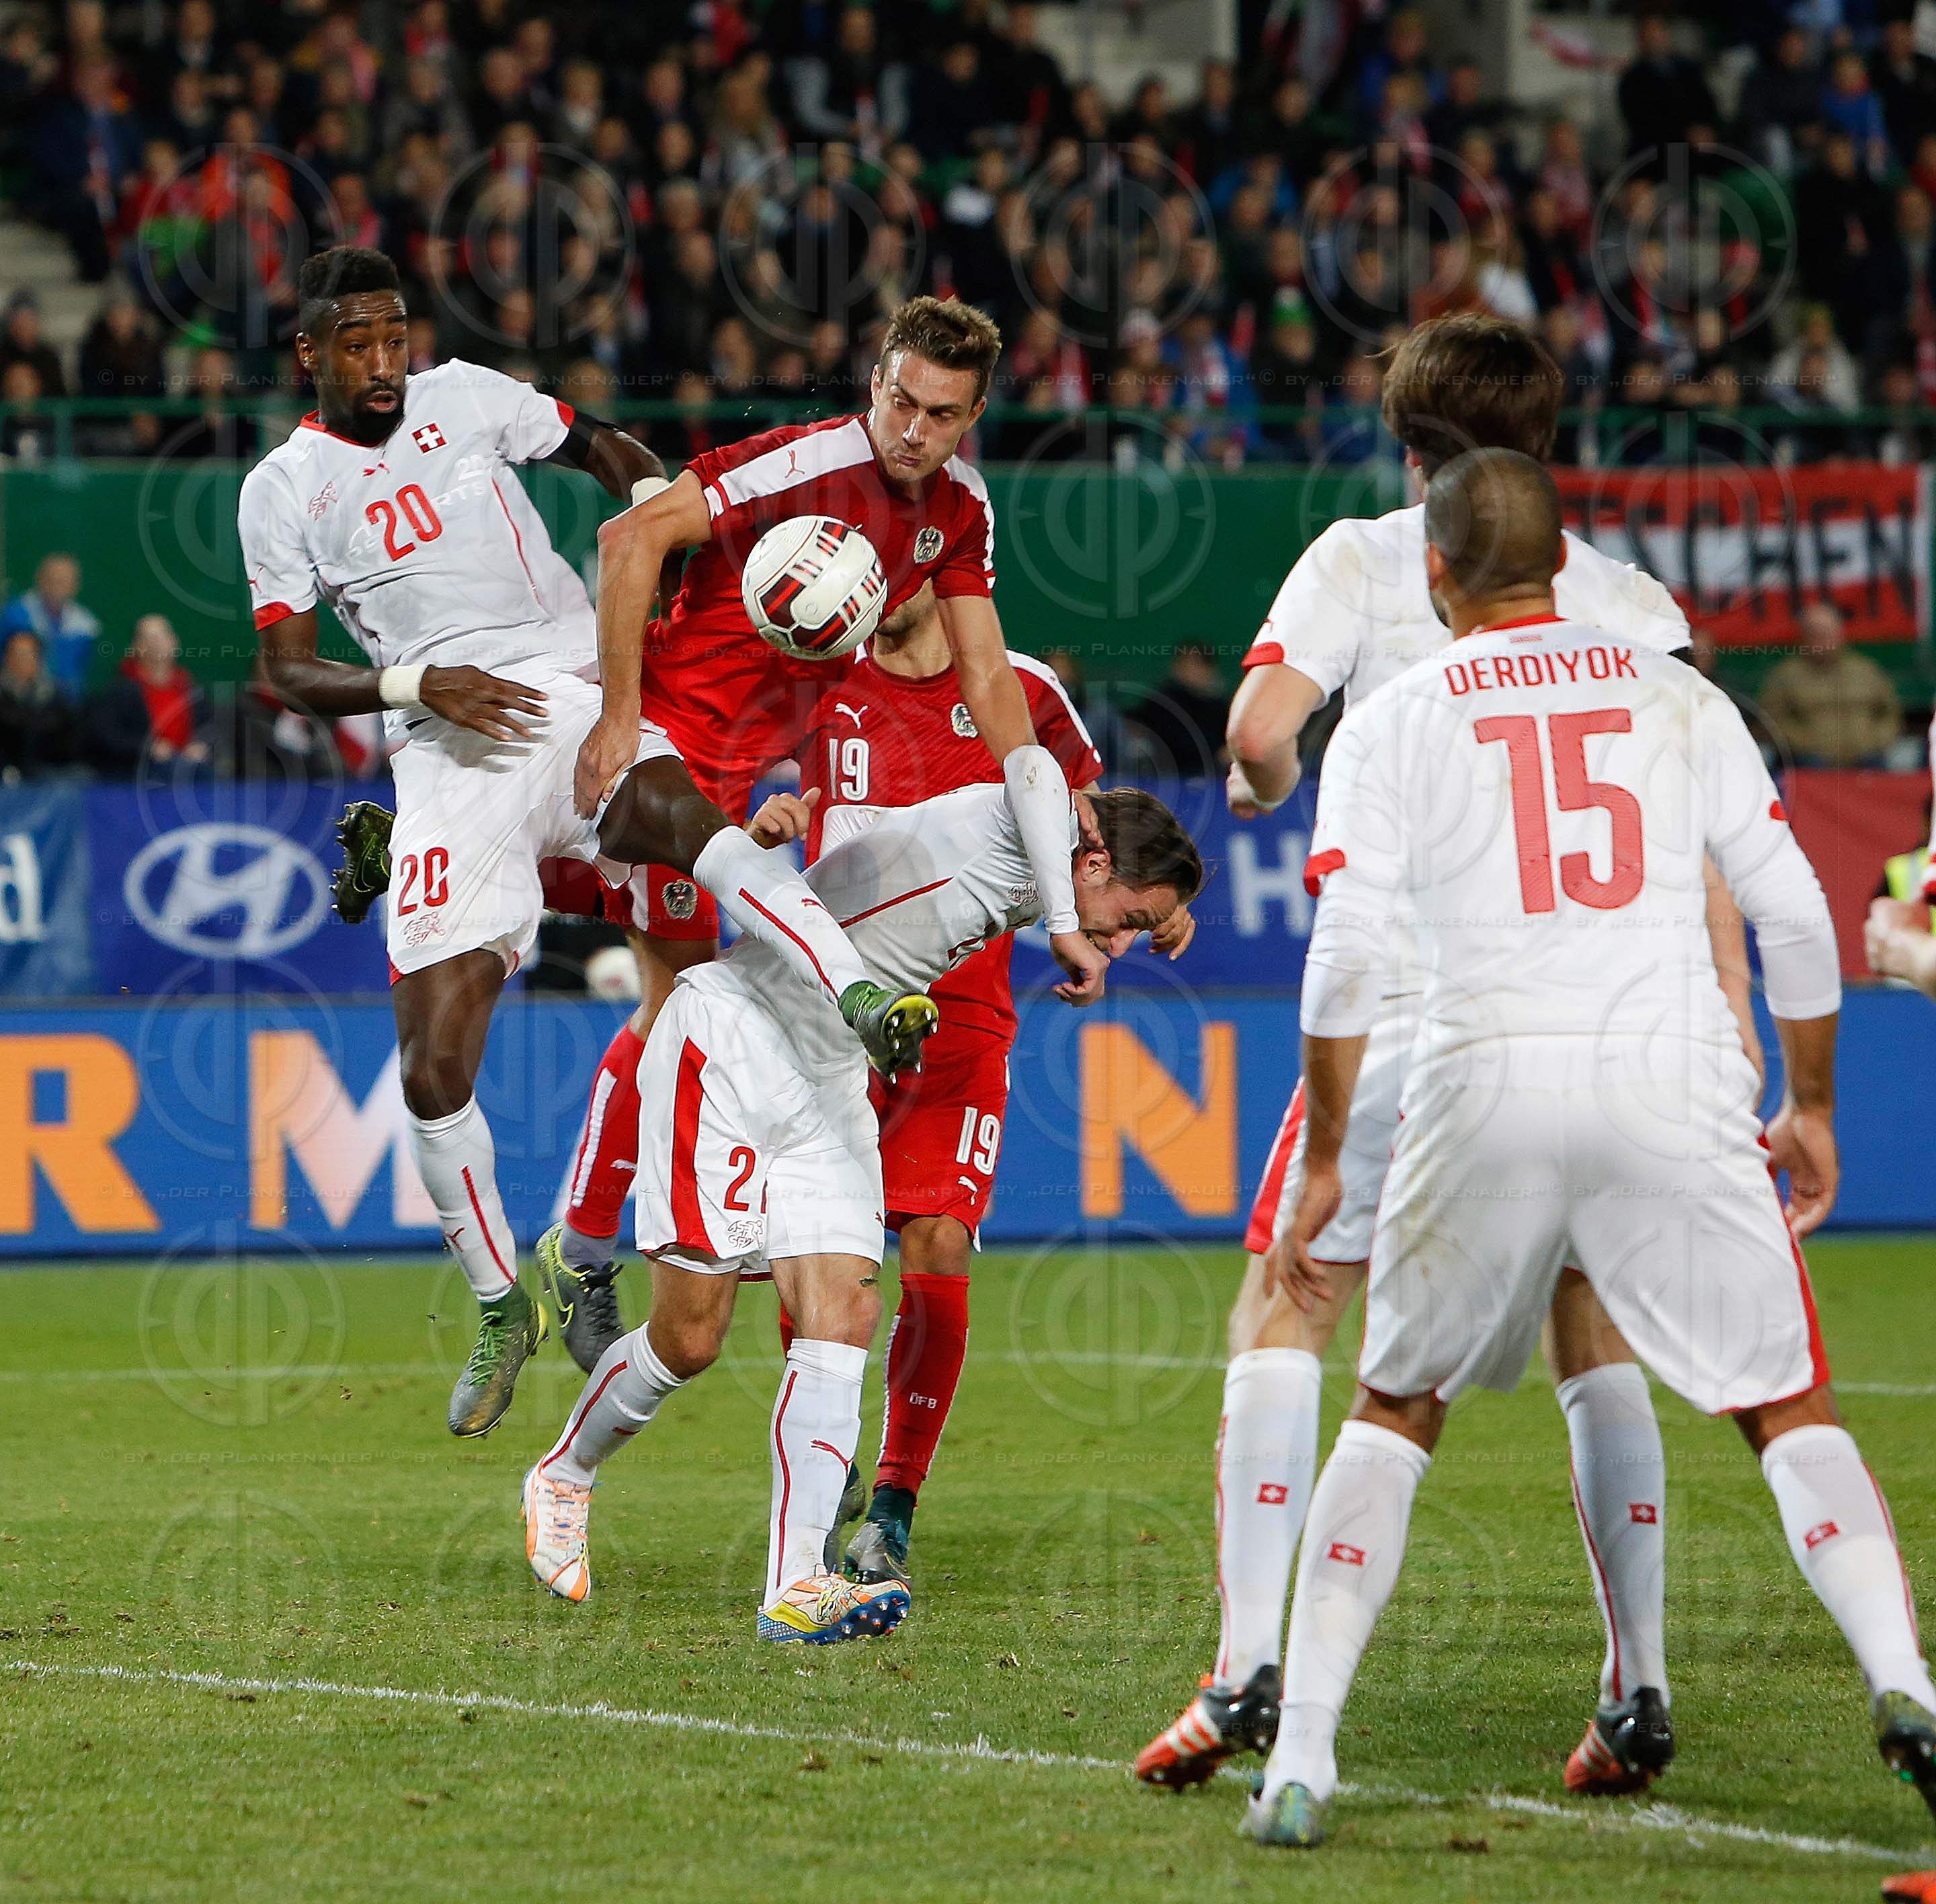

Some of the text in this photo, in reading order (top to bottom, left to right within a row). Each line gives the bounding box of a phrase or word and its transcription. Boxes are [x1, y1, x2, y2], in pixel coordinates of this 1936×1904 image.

[365, 483, 443, 562] 20
[1444, 646, 1638, 696] DERDIYOK
[828, 738, 869, 801] 19
[1474, 708, 1644, 914] 15
[398, 846, 448, 917] 20
[956, 1106, 1001, 1175] 19
[723, 1146, 768, 1214] 2
